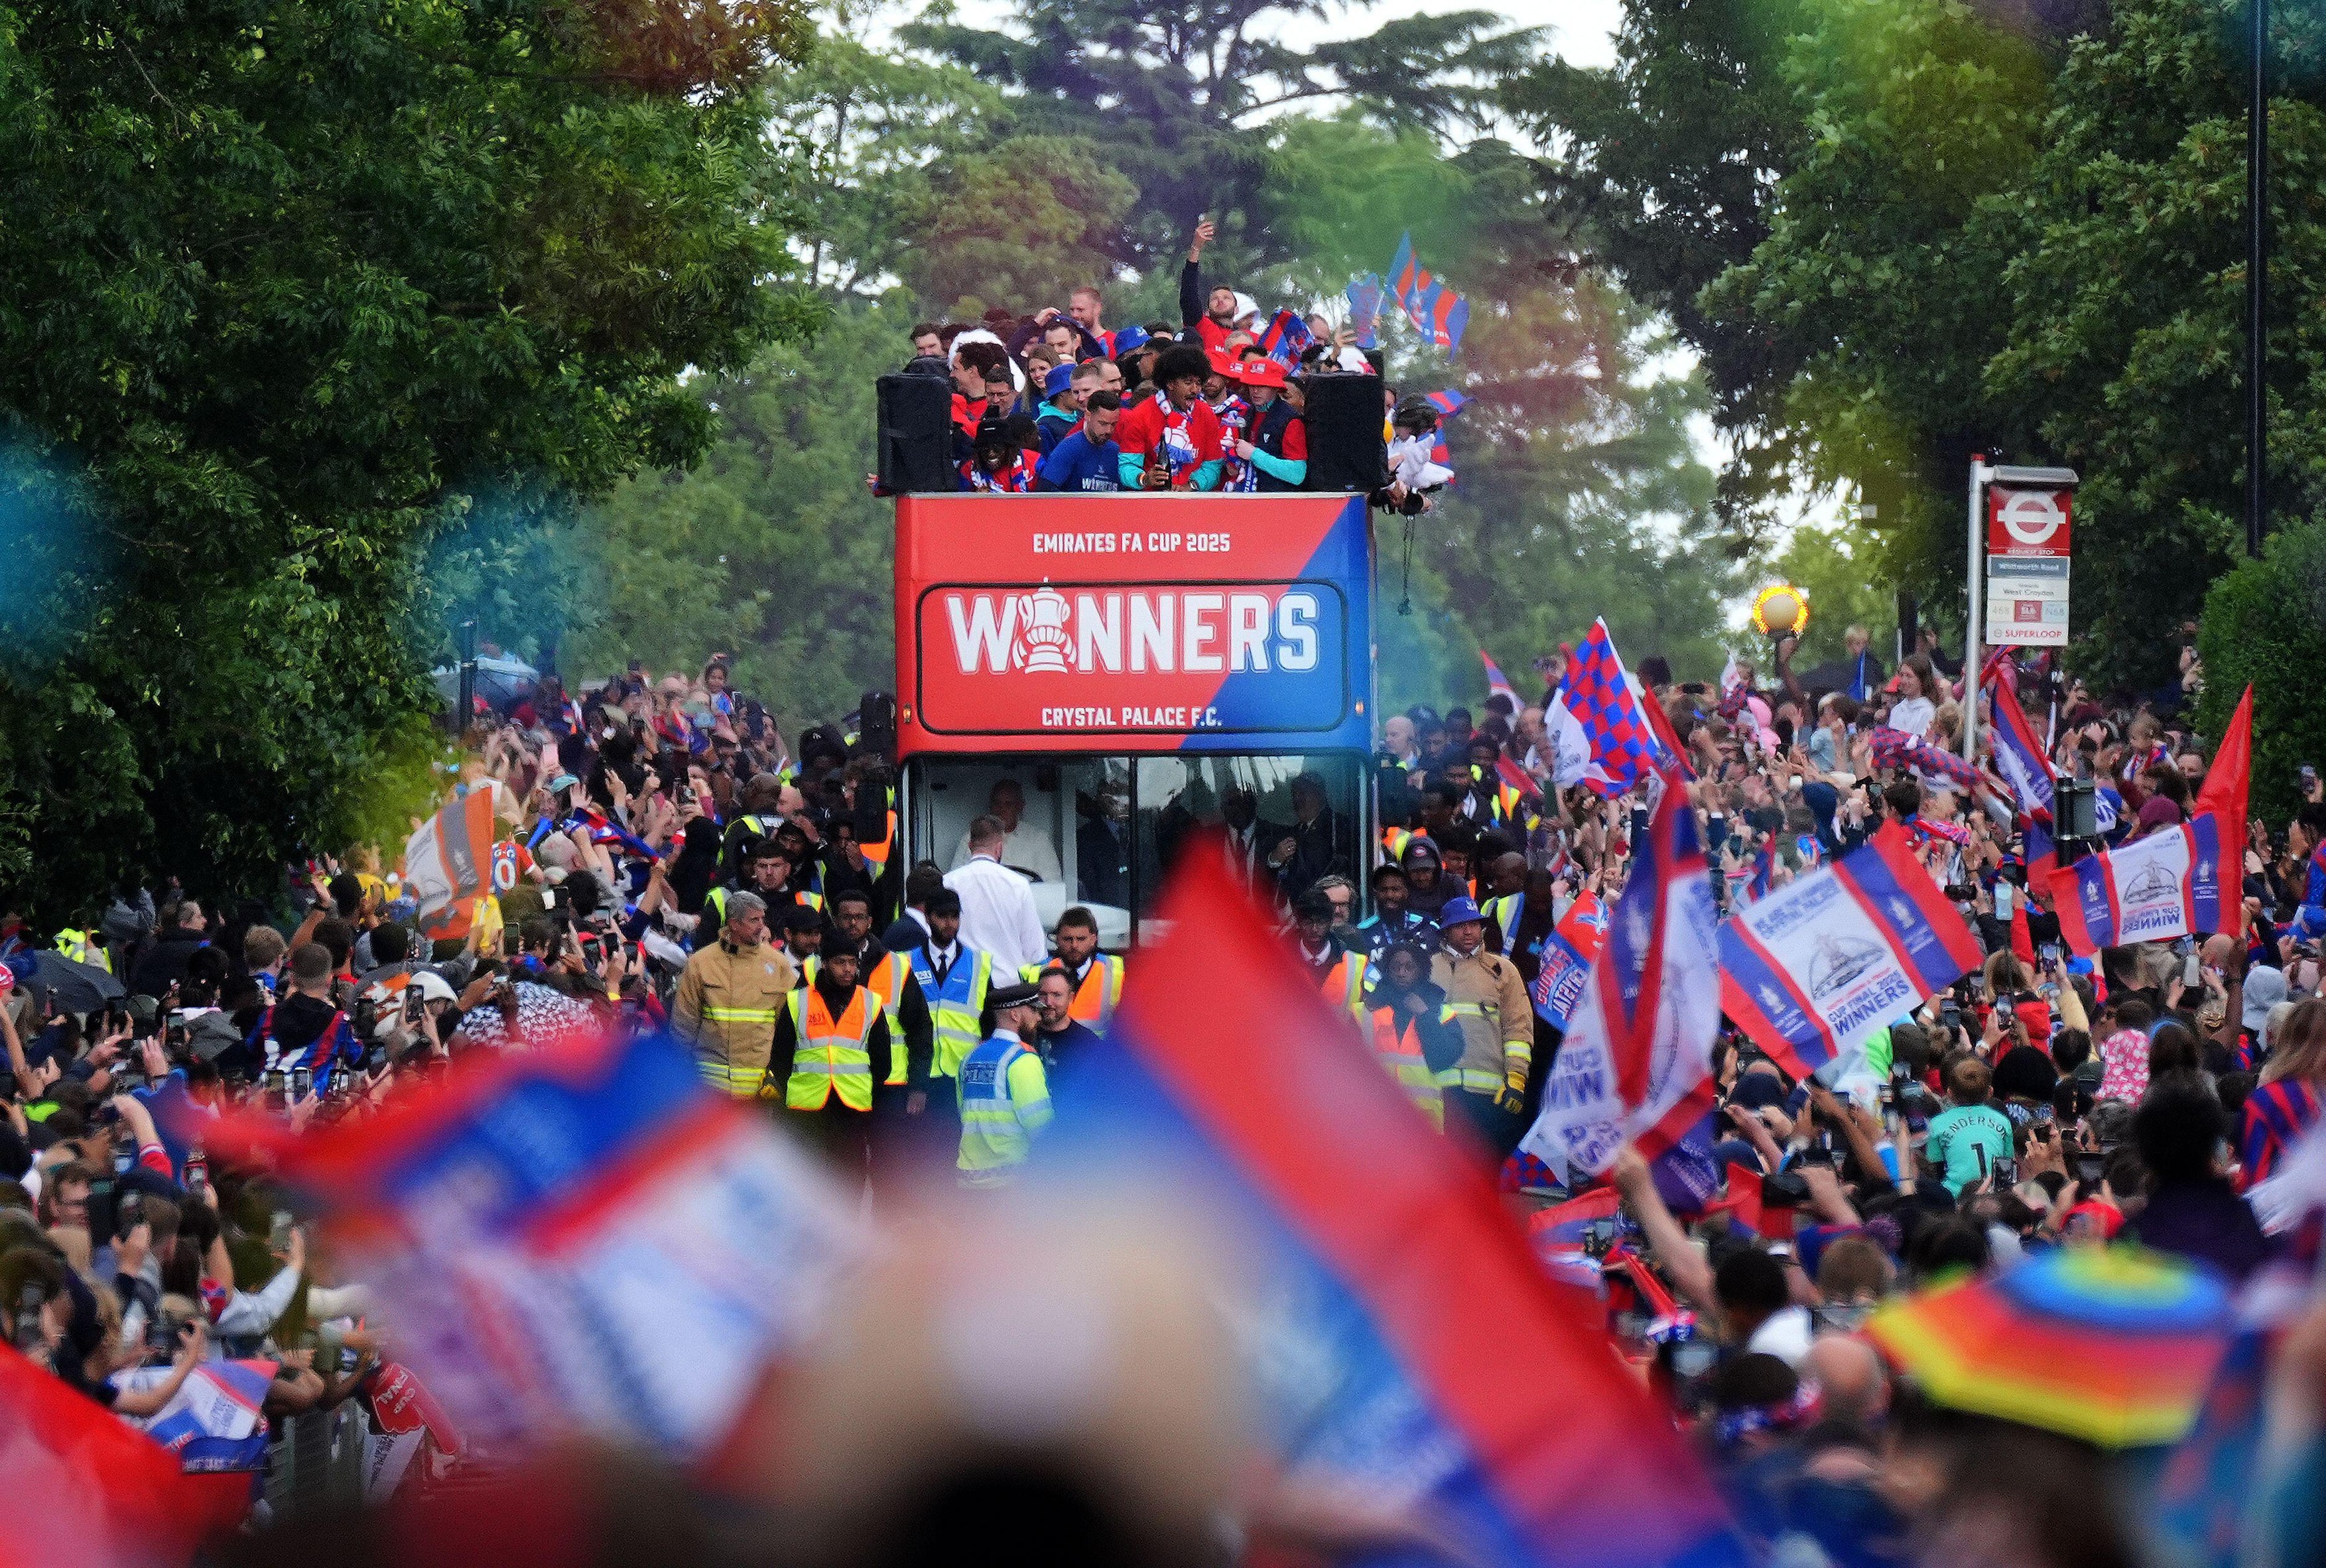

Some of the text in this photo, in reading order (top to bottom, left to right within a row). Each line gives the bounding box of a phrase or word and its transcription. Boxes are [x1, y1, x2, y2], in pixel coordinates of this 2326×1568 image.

[1033, 533, 1231, 553] EMIRATES FA CUP 2025
[1041, 707, 1223, 726] CRYSTAL PALACE F.C.
[1834, 979, 1911, 1037] WINNERS
[1970, 1142, 1988, 1180] 1
